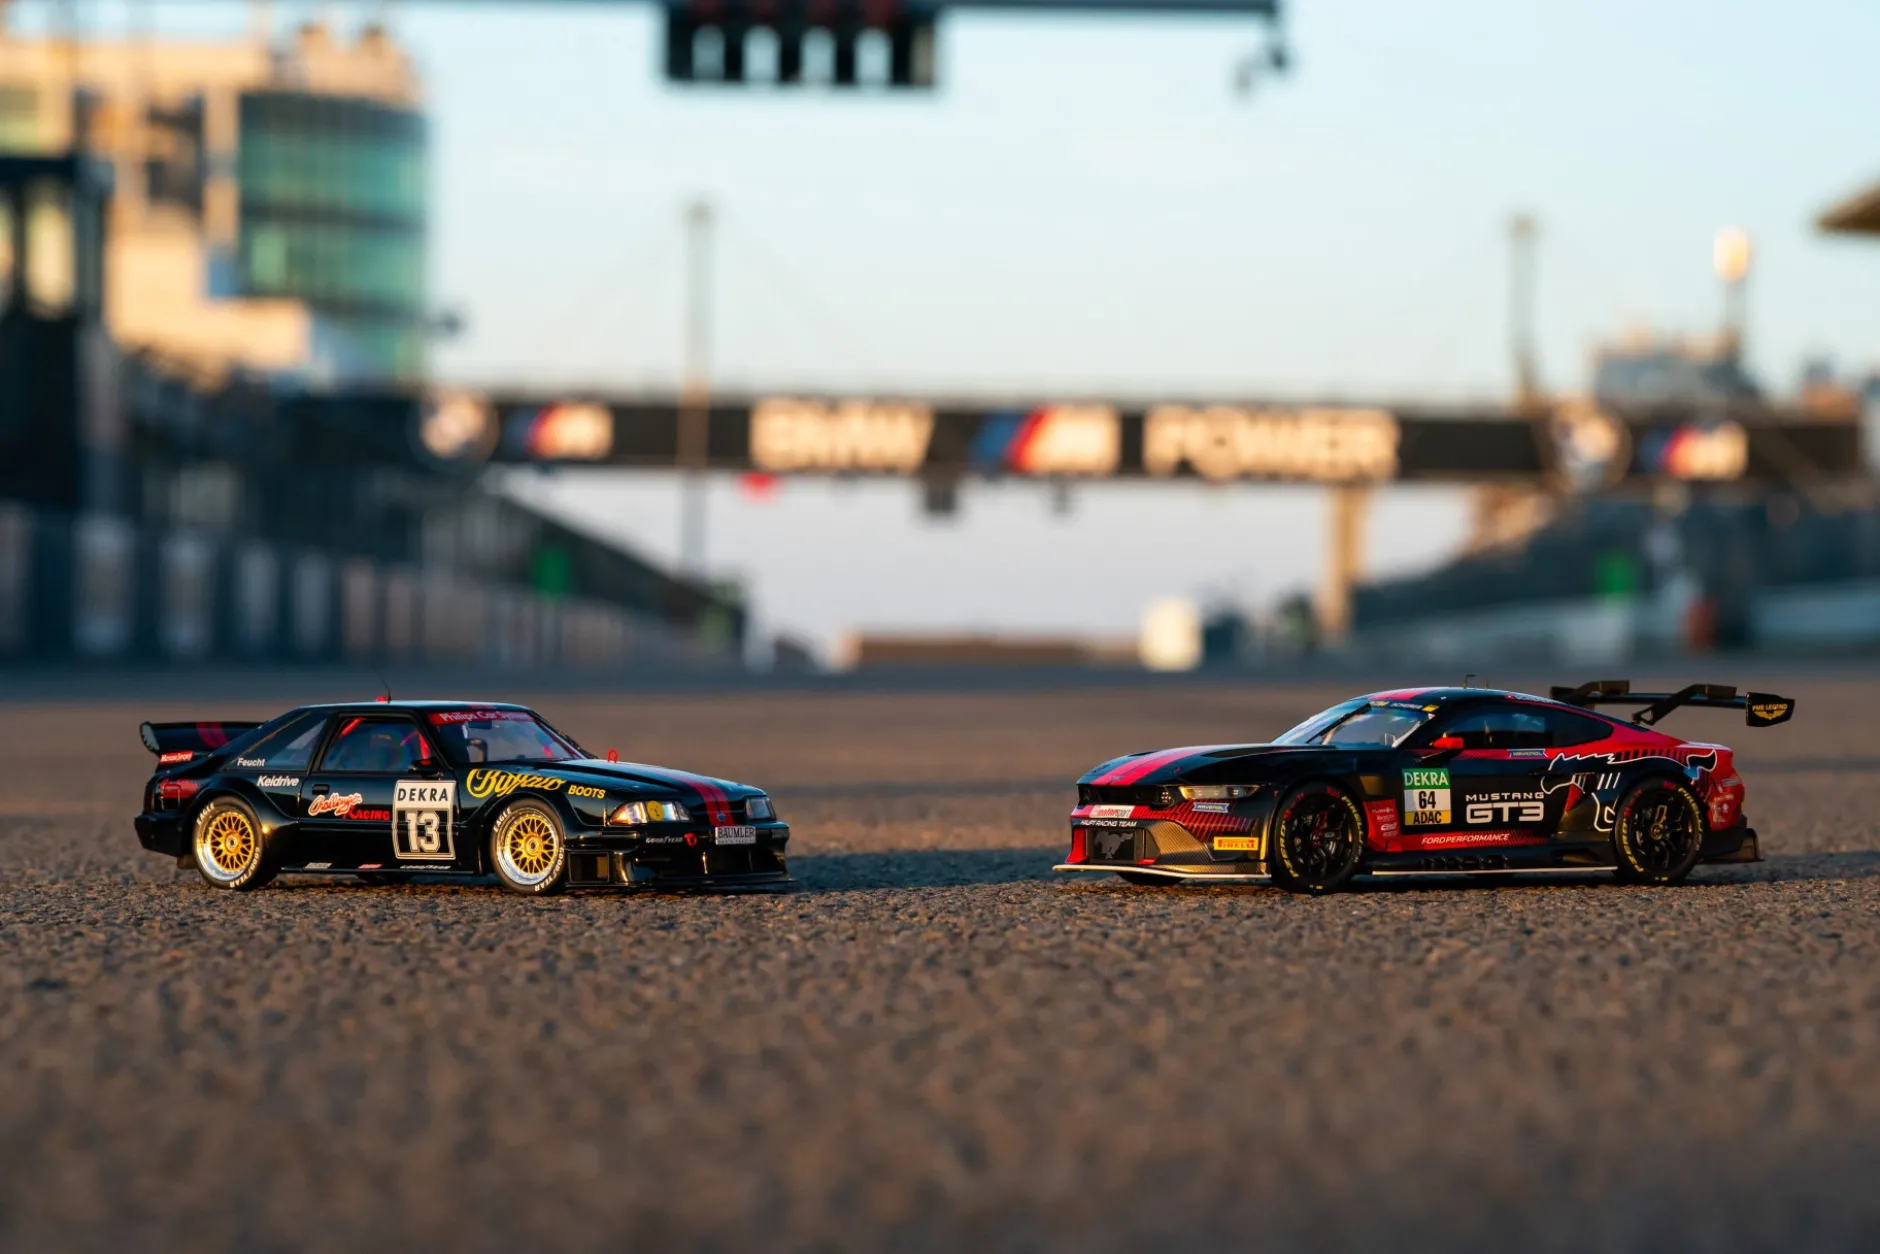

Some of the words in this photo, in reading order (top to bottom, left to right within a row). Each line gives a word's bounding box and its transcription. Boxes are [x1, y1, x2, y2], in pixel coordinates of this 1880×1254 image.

[750, 400, 932, 472] BMW
[1143, 405, 1398, 480] POWER
[237, 758, 265, 767] Feucht
[466, 768, 567, 798] Buffalo
[1404, 772, 1448, 785] DEKRA
[398, 788, 448, 801] DEKRA
[568, 785, 606, 799] BOOTS
[1466, 792, 1544, 801] MUSTANG
[1418, 790, 1436, 809] 64
[493, 807, 512, 832] EAGLE
[1413, 811, 1442, 825] ADAC
[1466, 801, 1545, 824] GT3
[1118, 820, 1138, 828] TEAM
[405, 811, 441, 853] 13
[1421, 837, 1446, 845] FORD
[1445, 833, 1510, 843] PERFORMANCE
[1217, 839, 1256, 848] PIRELLI
